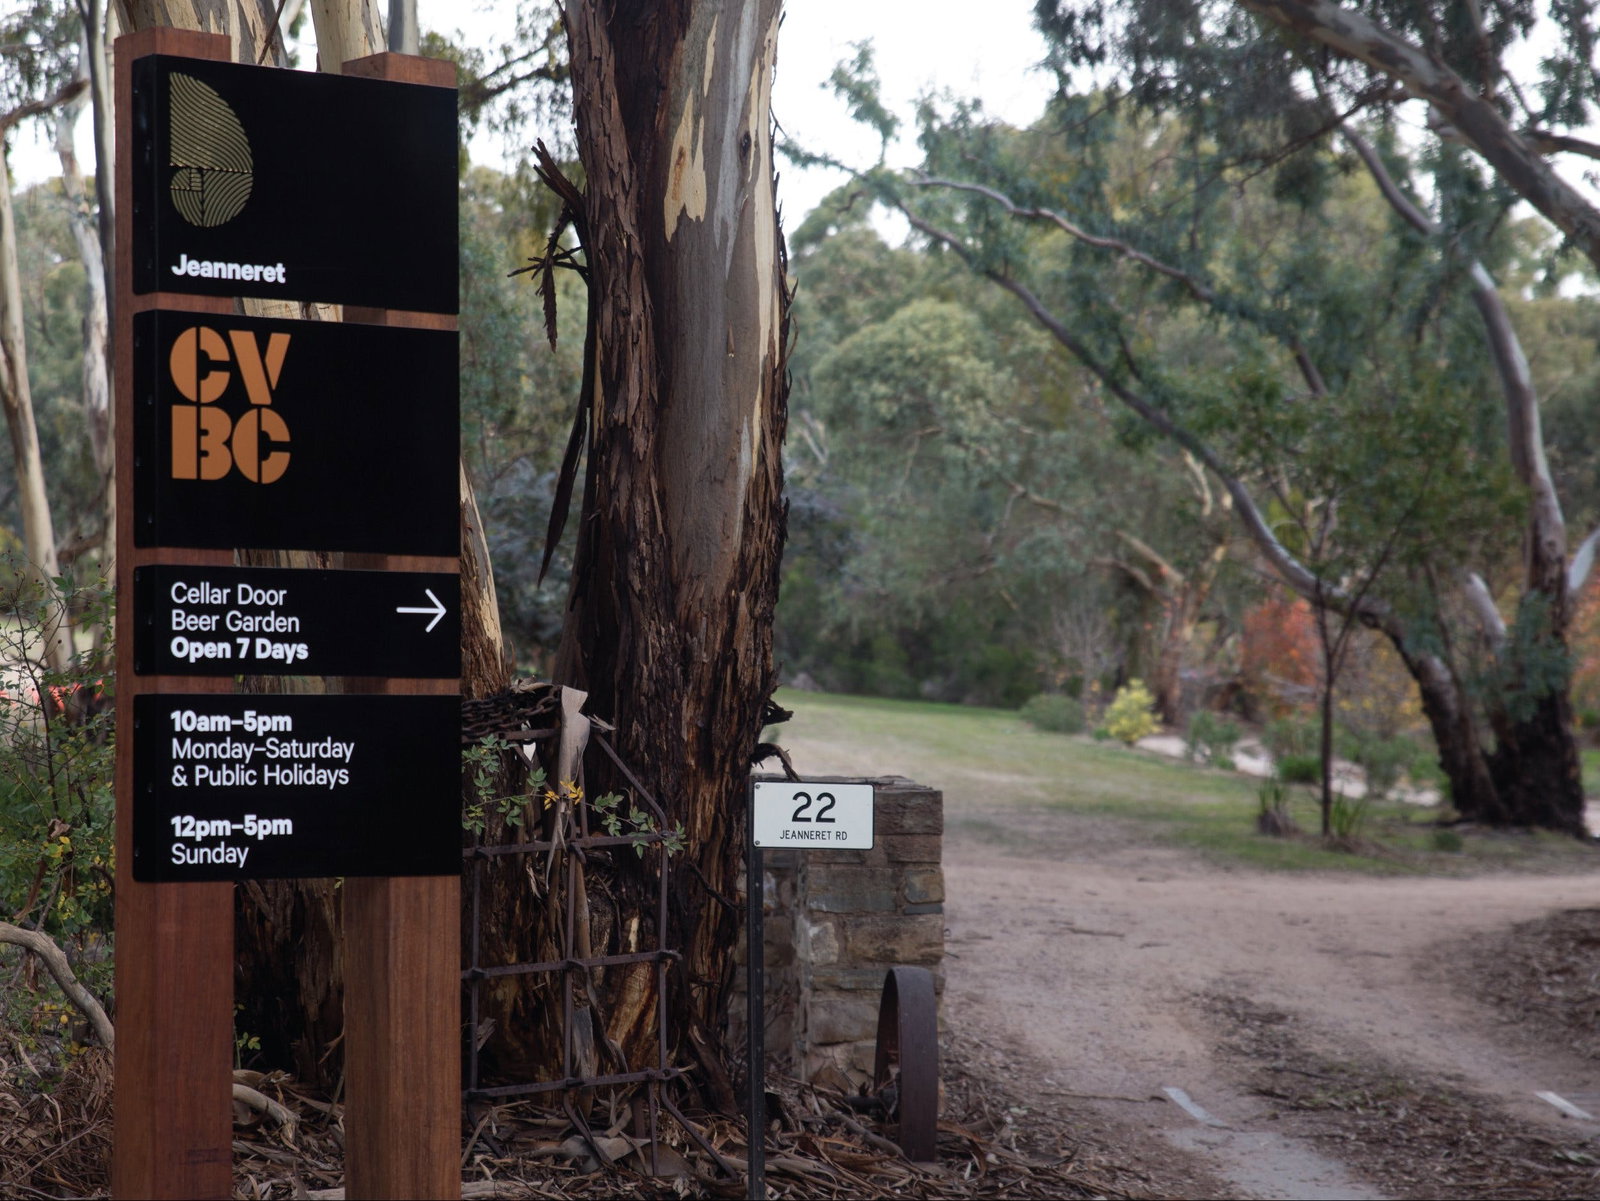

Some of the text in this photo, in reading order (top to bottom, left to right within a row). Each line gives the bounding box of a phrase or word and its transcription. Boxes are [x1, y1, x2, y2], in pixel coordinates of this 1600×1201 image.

[171, 254, 286, 284] Jeanneret
[170, 327, 290, 404] CV
[172, 405, 290, 483] BC
[171, 582, 287, 605] Cellar Door
[172, 609, 299, 632] Beer Garden
[171, 636, 308, 664] Open 7 Days
[172, 763, 349, 789] & Public Holidays
[792, 792, 835, 823] 22
[779, 830, 848, 841] JEANNERET RD
[171, 842, 249, 868] Sunday
